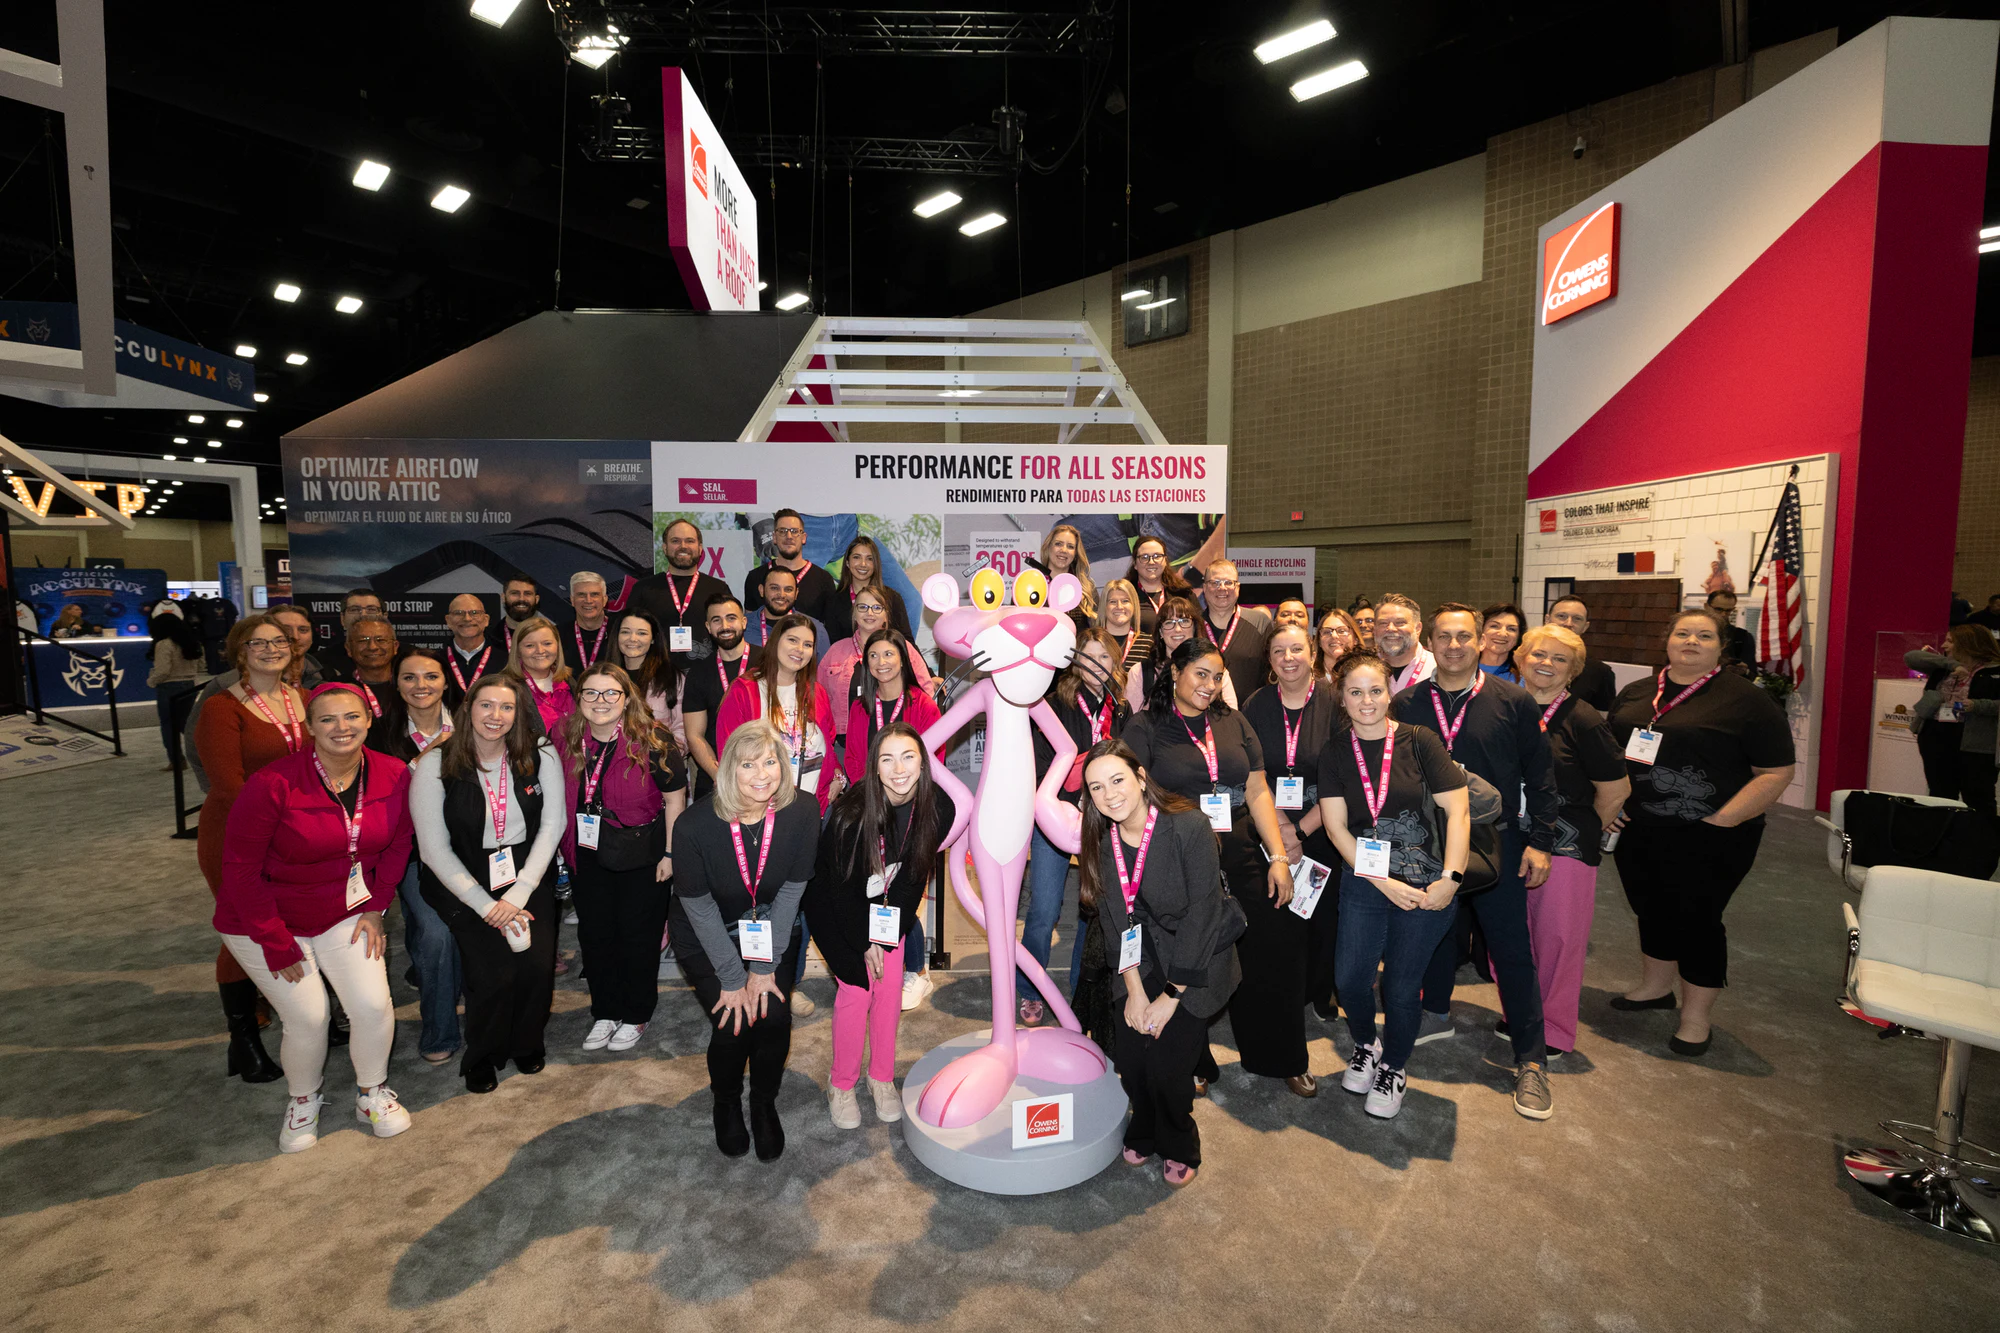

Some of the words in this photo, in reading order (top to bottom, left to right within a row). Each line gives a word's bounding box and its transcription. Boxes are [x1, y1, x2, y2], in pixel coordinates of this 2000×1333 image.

[714, 164, 738, 229] MORE
[715, 205, 738, 264] THAN
[740, 242, 755, 288] JUST
[718, 249, 723, 284] A
[725, 258, 745, 309] ROOF
[1558, 253, 1608, 289] OWENS
[1548, 270, 1608, 310] CORNING
[114, 335, 217, 382] CCULYNX
[301, 457, 390, 478] OPTIMIZE
[396, 458, 478, 478] AIRFLOW
[604, 464, 644, 473] BREATHE.
[855, 454, 1014, 479] PERFORMANCE
[1020, 455, 1061, 480] FOR
[1068, 456, 1105, 480] ALL
[1111, 456, 1206, 480] SEASONS
[604, 474, 638, 482] RESPIRAR.
[703, 482, 724, 492] SEAL.
[302, 481, 322, 501] IN
[328, 481, 382, 501] YOUR
[388, 481, 440, 502] ATTIC
[946, 489, 1026, 503] RENDIMIENTO
[1030, 489, 1063, 503] PARA
[1067, 489, 1106, 503] TODAS
[1110, 489, 1132, 503] LAS
[1136, 489, 1206, 503] ESTACIONES
[304, 511, 360, 523] OPTIMIZAR
[362, 511, 373, 522] EL
[376, 511, 406, 523] FLUJO
[410, 511, 422, 522] DE
[424, 511, 448, 522] AIRE
[451, 511, 462, 523] EN
[465, 511, 479, 523] SU
[482, 508, 512, 524] ÁTICO
[1564, 505, 1592, 518] COLORS
[1596, 502, 1614, 514] THAT
[1616, 497, 1650, 512] INSPIRE
[1563, 526, 1584, 537] COLORES
[1584, 526, 1594, 536] QUE
[1265, 558, 1306, 568] RECYCLING
[29, 578, 148, 596] ACCULYNX
[385, 602, 402, 612] OOT
[404, 602, 433, 612] STRIP
[1029, 1126, 1058, 1134] CORNING
[1034, 1119, 1058, 1128] OWENS
